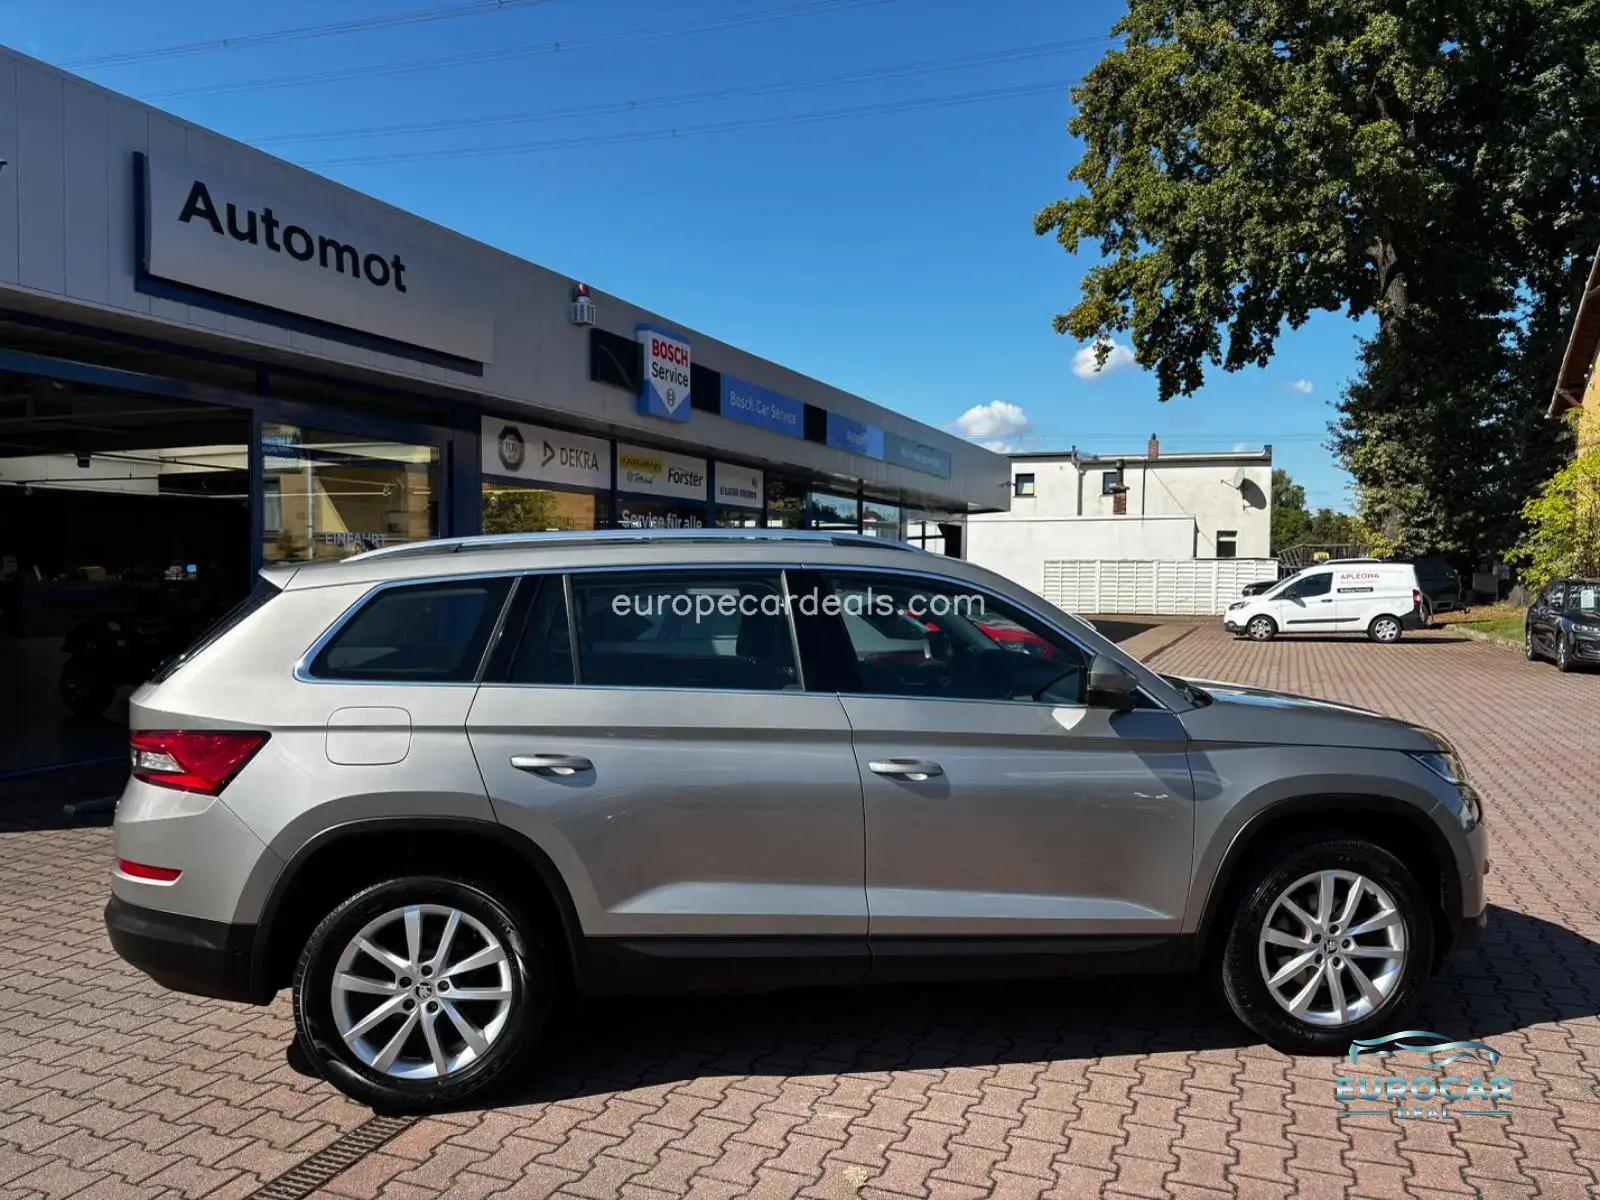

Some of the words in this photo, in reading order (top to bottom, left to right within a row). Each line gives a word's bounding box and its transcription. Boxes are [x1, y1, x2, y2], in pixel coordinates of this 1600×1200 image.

[178, 180, 406, 293] Automot
[651, 337, 689, 367] BOSCH
[651, 361, 689, 388] Service
[729, 390, 755, 412] Bosch
[756, 399, 771, 417] Car
[771, 403, 797, 425] Service
[560, 447, 599, 472] DEKRA
[667, 467, 704, 487] Forster
[622, 509, 665, 528] Service
